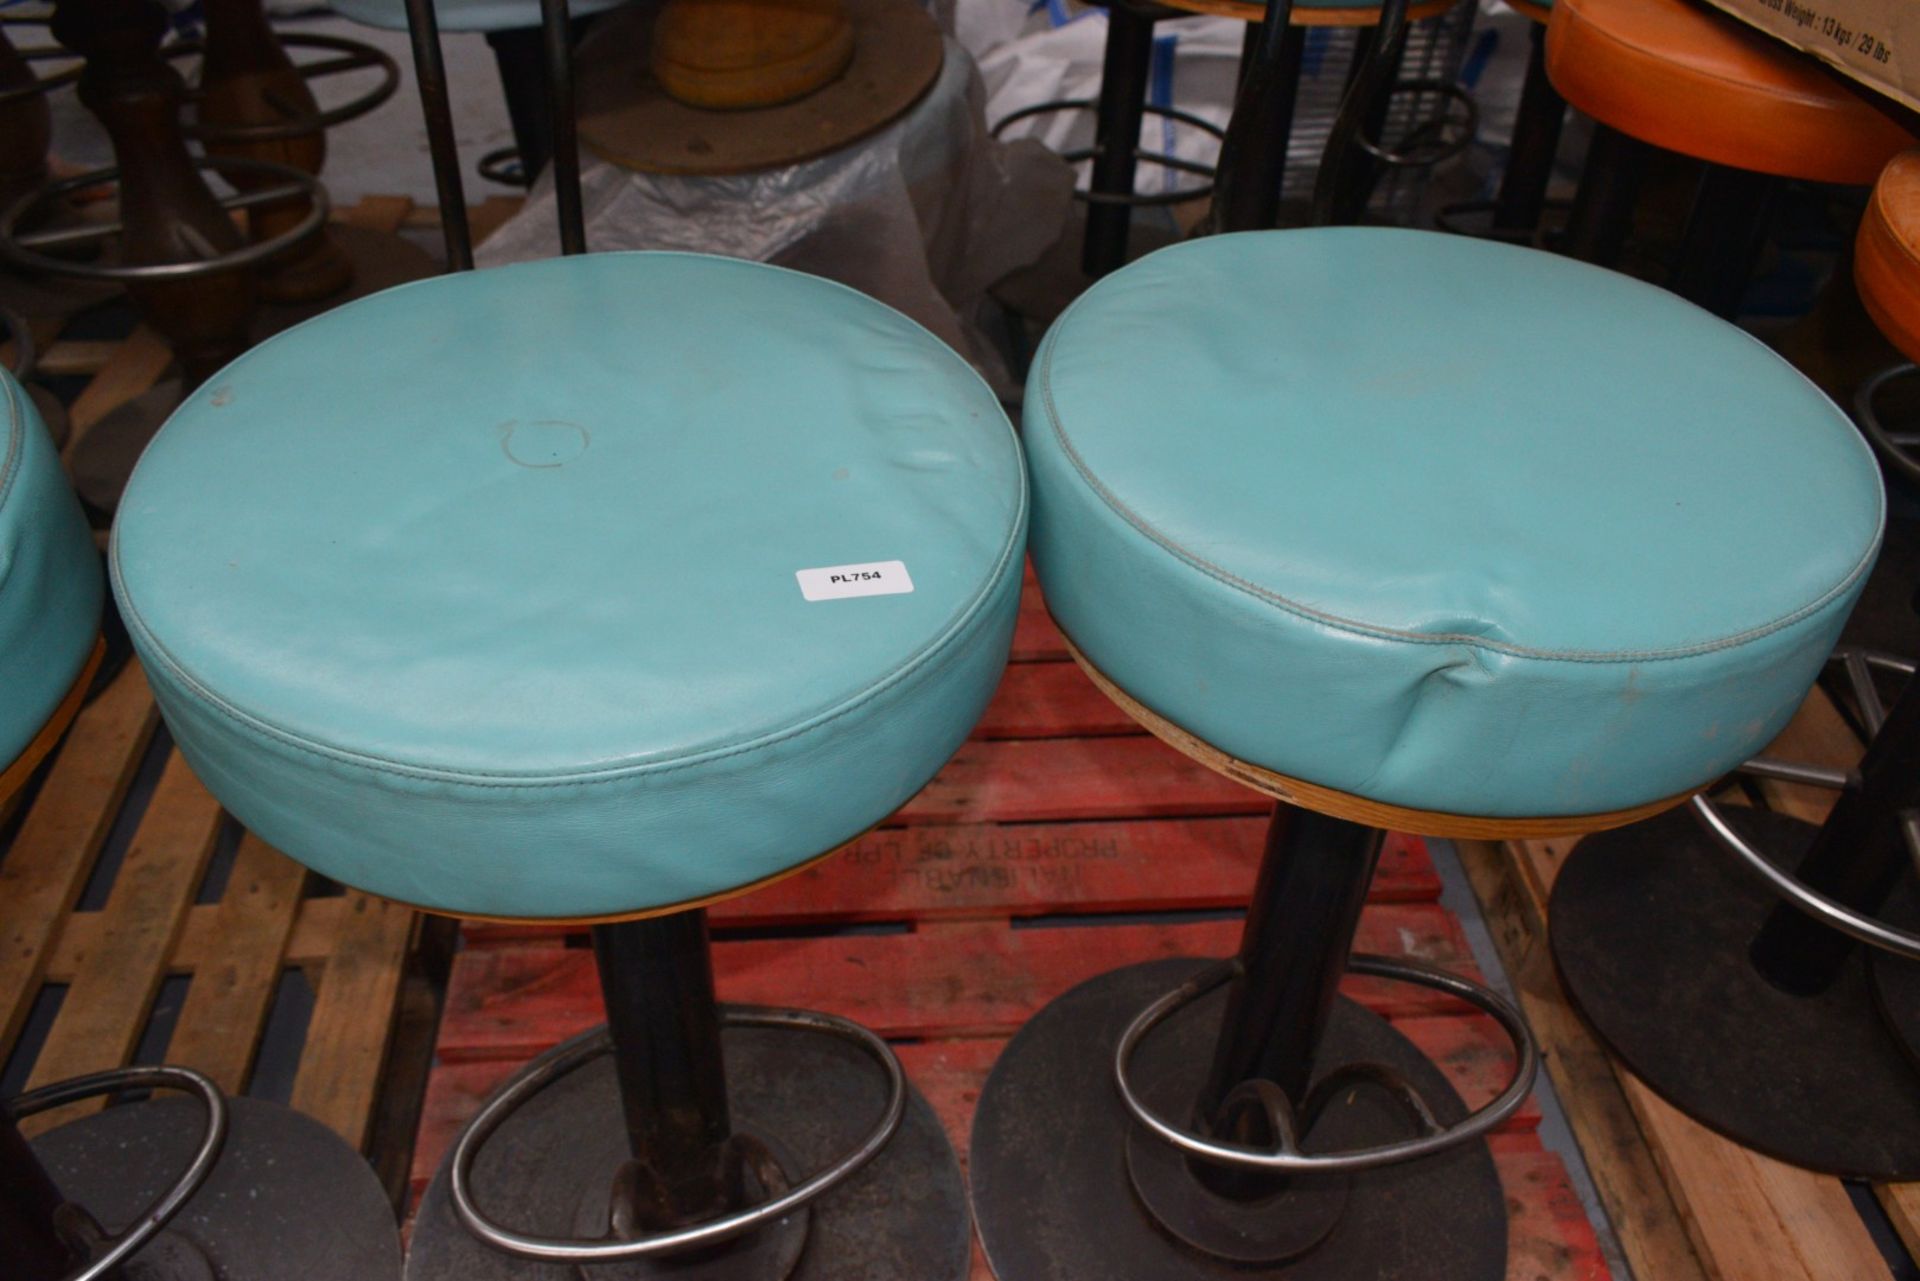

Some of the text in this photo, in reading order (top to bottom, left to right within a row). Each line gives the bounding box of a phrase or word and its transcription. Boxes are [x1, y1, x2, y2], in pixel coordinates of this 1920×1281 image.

[1784, 0, 1815, 27] Weight
[1858, 33, 1874, 55] 29
[1873, 41, 1891, 64] lbs
[830, 572, 881, 583] PL754
[965, 838, 1119, 861] PROPERTY
